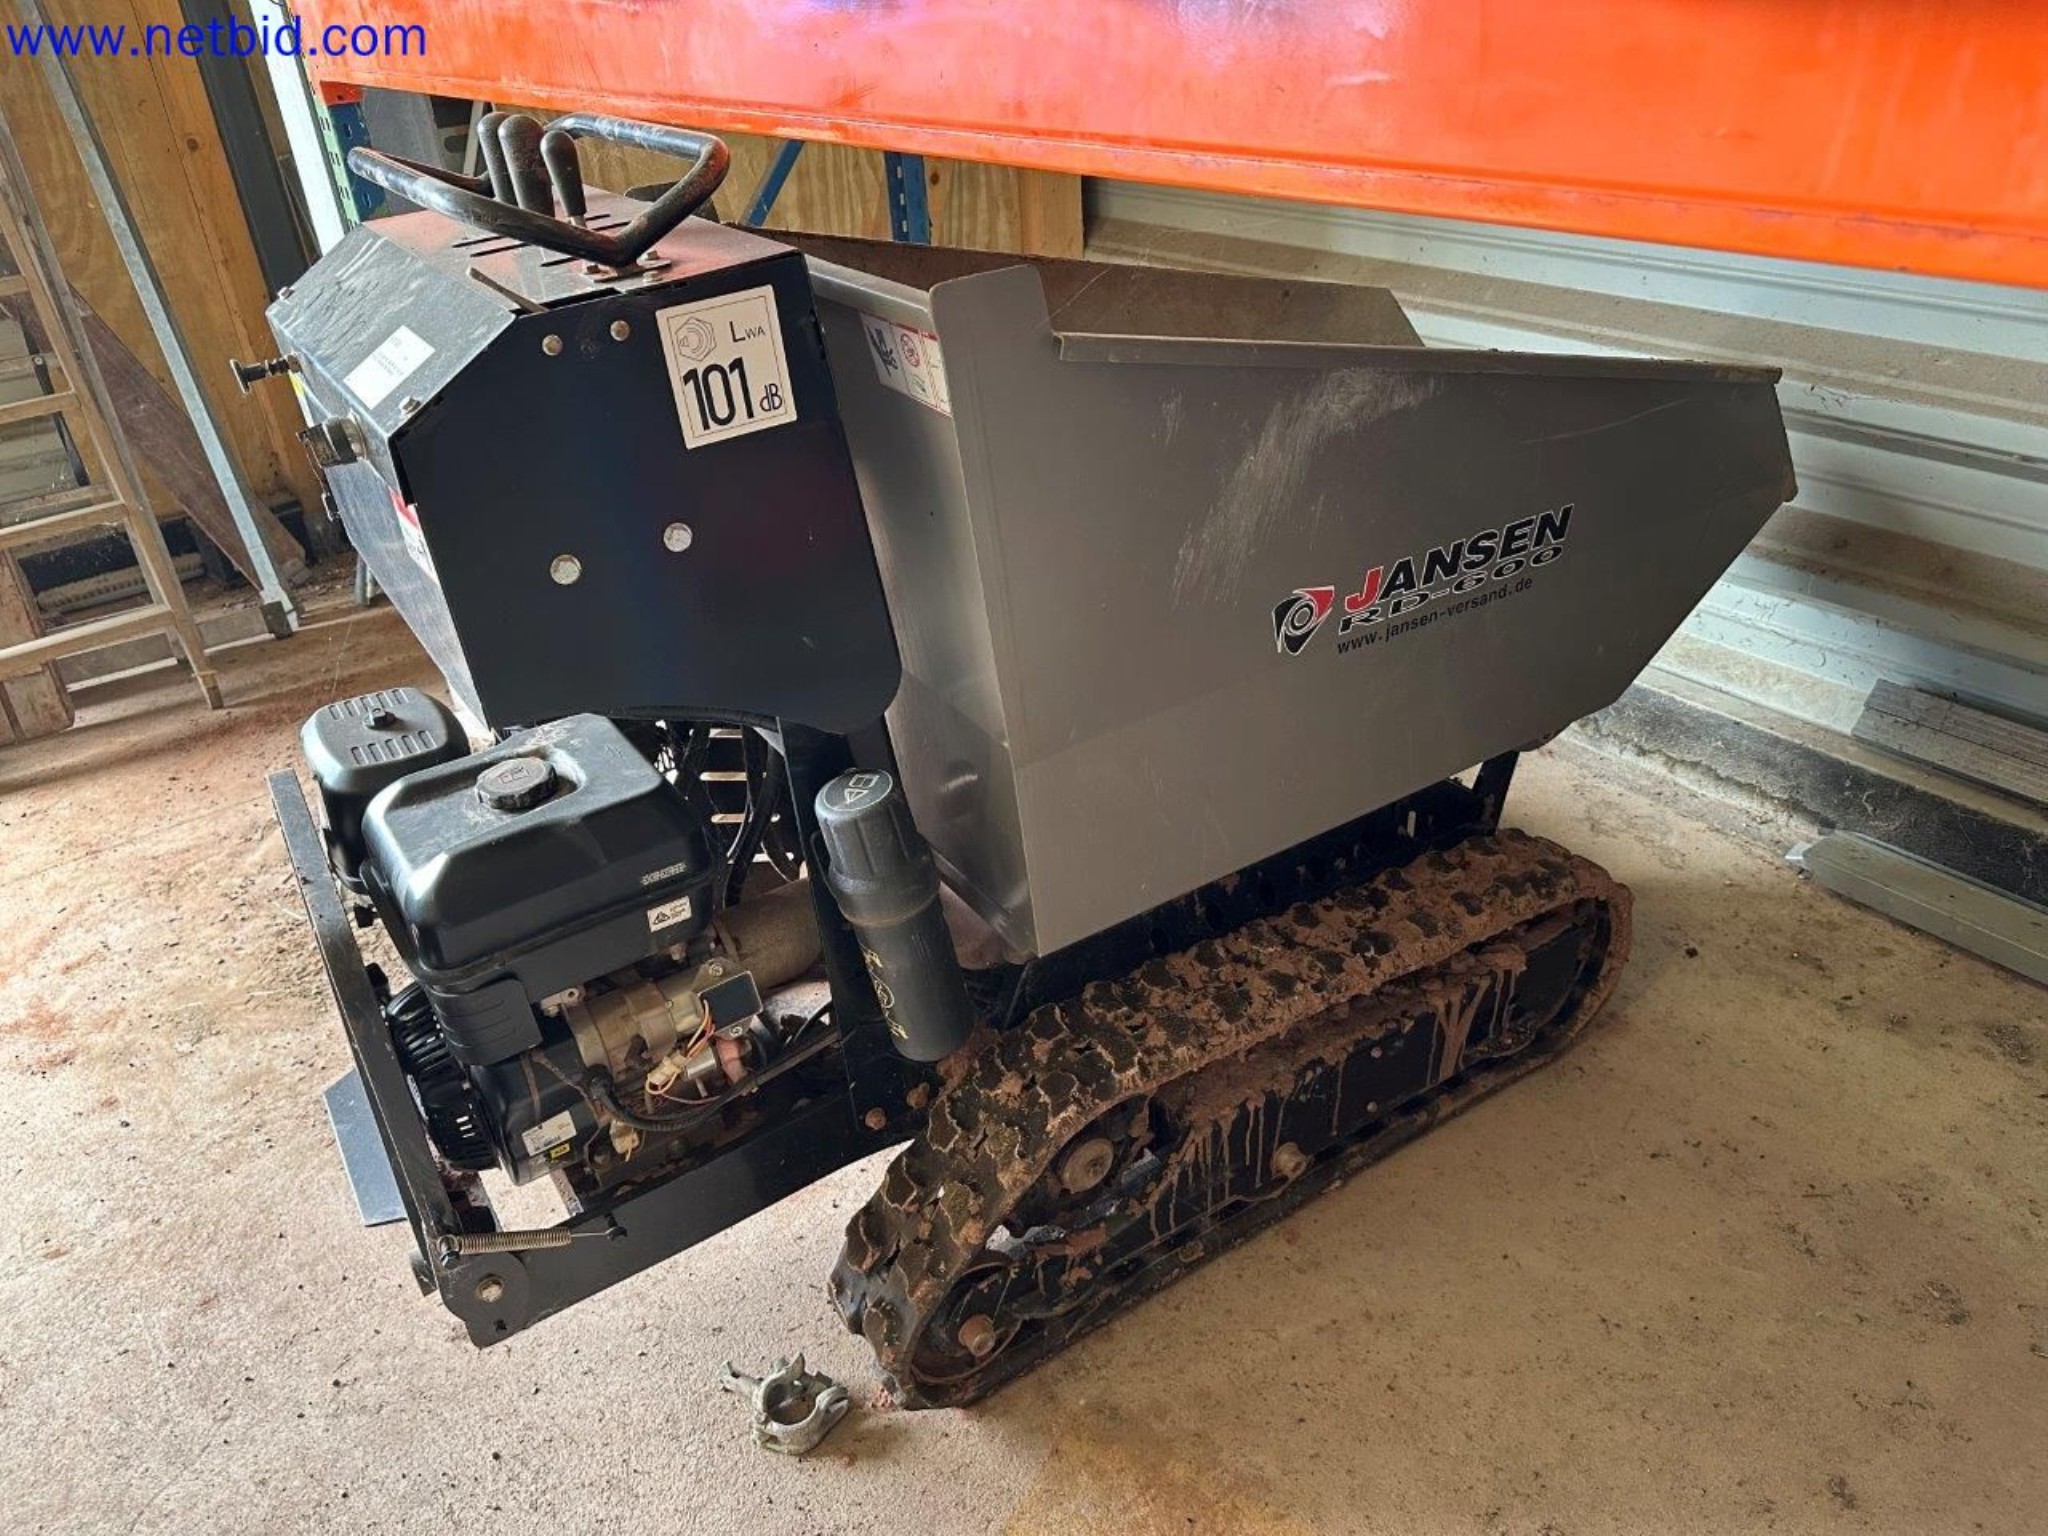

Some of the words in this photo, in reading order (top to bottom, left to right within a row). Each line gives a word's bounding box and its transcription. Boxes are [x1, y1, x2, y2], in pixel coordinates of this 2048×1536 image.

[683, 356, 754, 431] 101
[760, 383, 783, 412] dB
[1338, 545, 1562, 635] RD-600
[1344, 505, 1574, 612] JANSEN
[1337, 577, 1533, 654] www.jansen-versand.de
